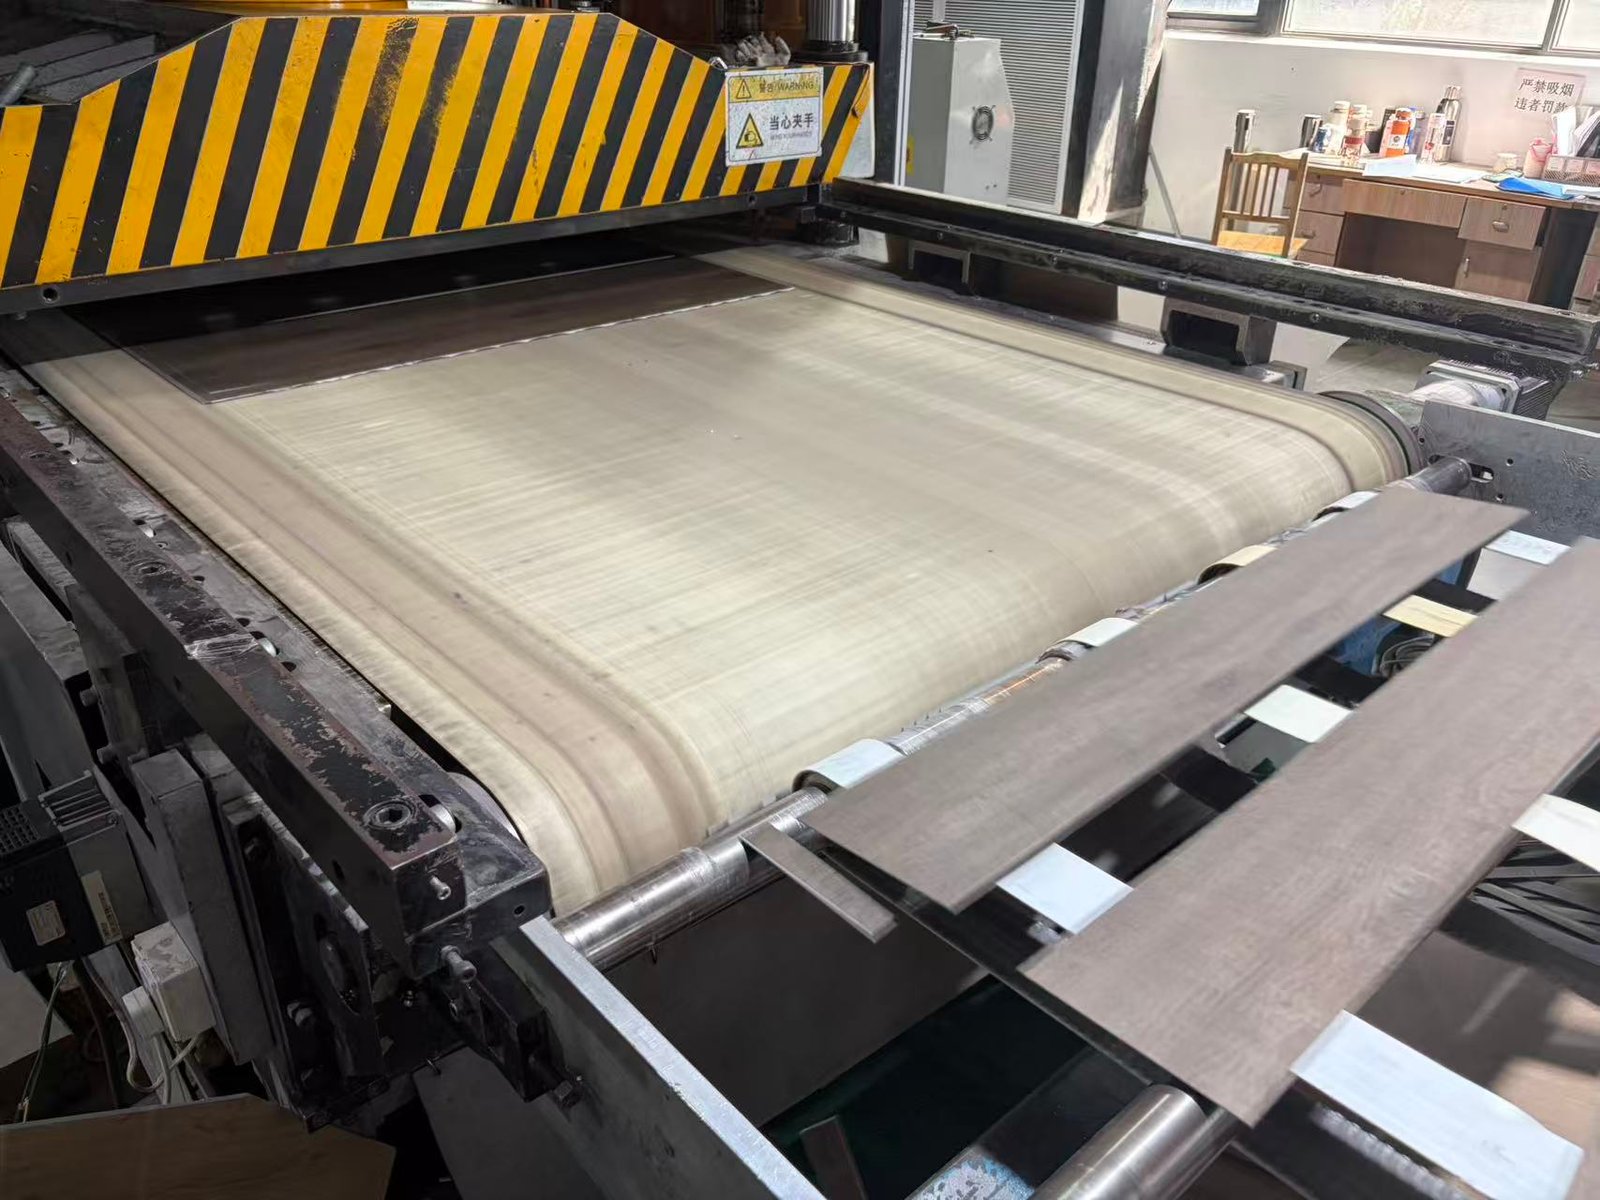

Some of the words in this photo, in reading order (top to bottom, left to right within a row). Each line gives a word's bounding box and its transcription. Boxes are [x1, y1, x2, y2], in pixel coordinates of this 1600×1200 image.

[1518, 78, 1575, 97] 严禁吸烟
[769, 112, 814, 131] 当心夹手
